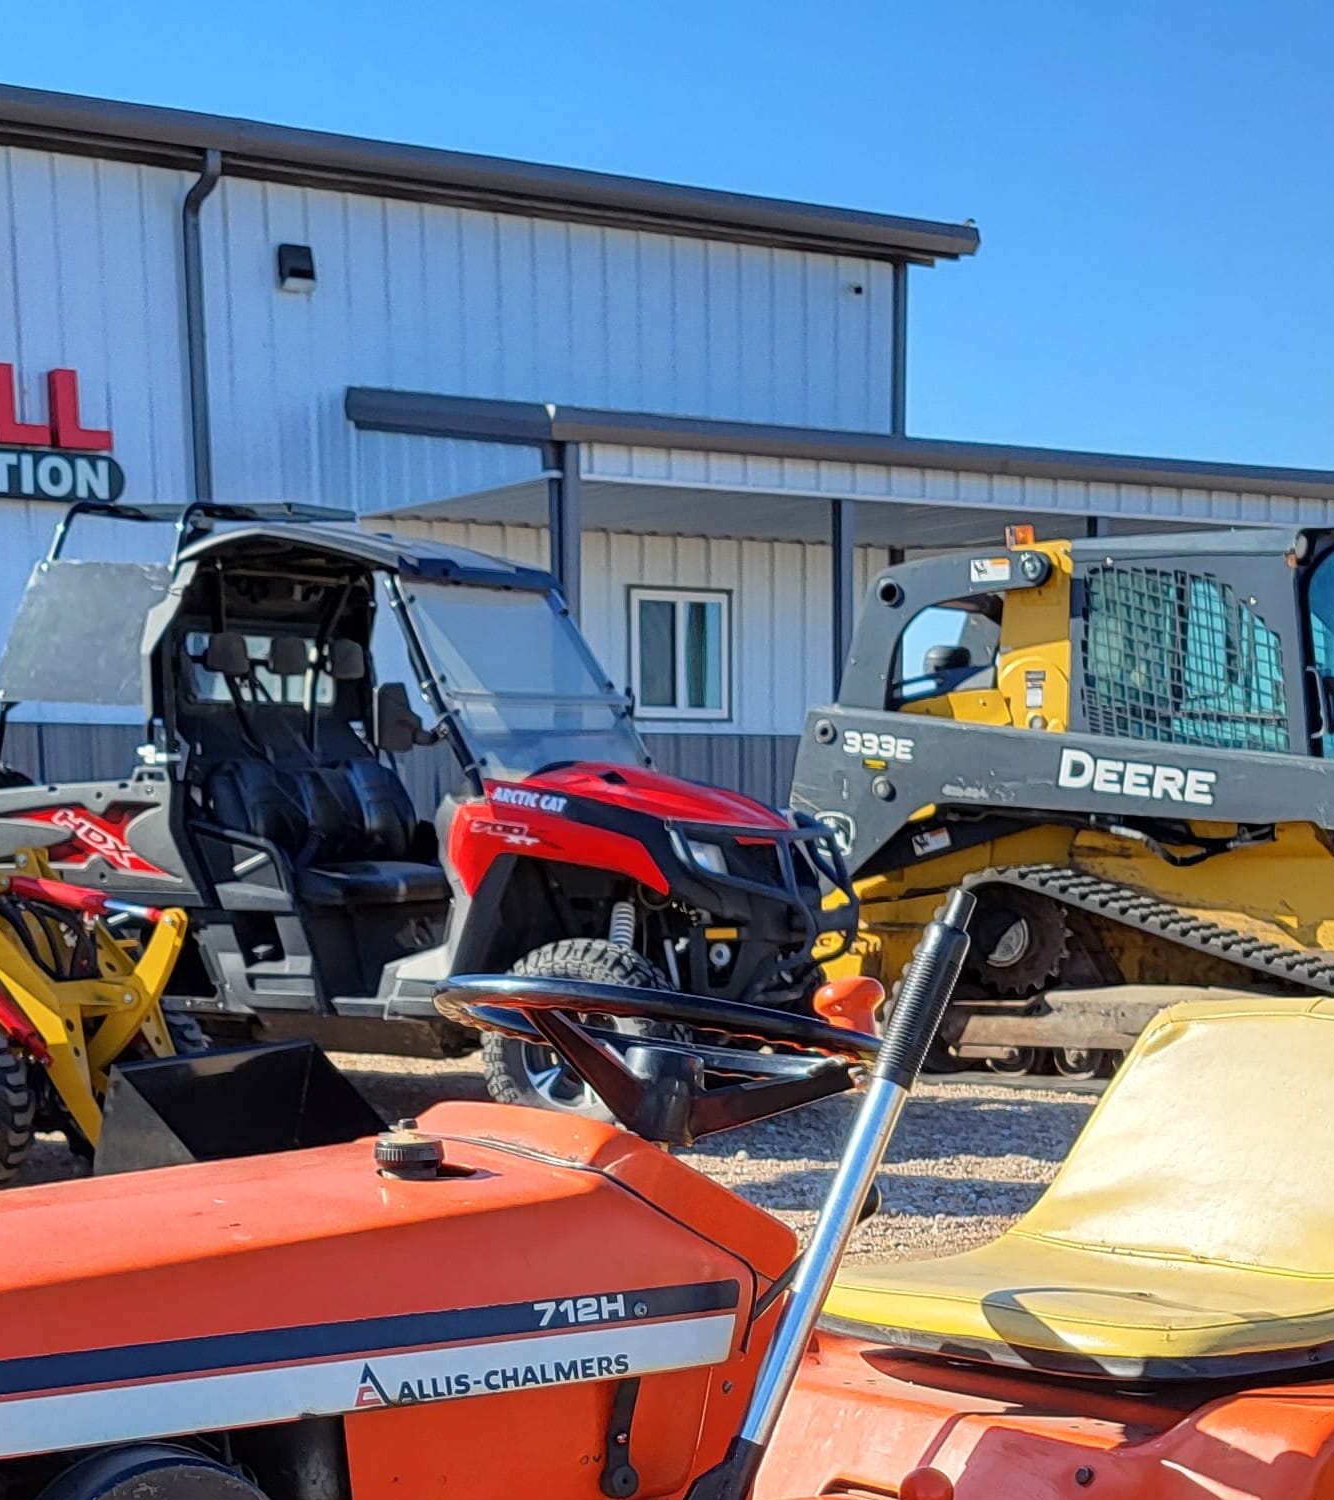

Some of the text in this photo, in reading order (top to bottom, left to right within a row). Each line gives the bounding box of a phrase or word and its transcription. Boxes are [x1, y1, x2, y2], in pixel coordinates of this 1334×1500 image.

[842, 730, 915, 761] 333E
[1058, 748, 1217, 806] DEERE
[491, 786, 568, 813] ARCTIC CAT
[51, 808, 137, 869] HDX
[533, 1294, 626, 1327] 712H
[398, 1354, 629, 1403] ALLIS-CHALMERS
